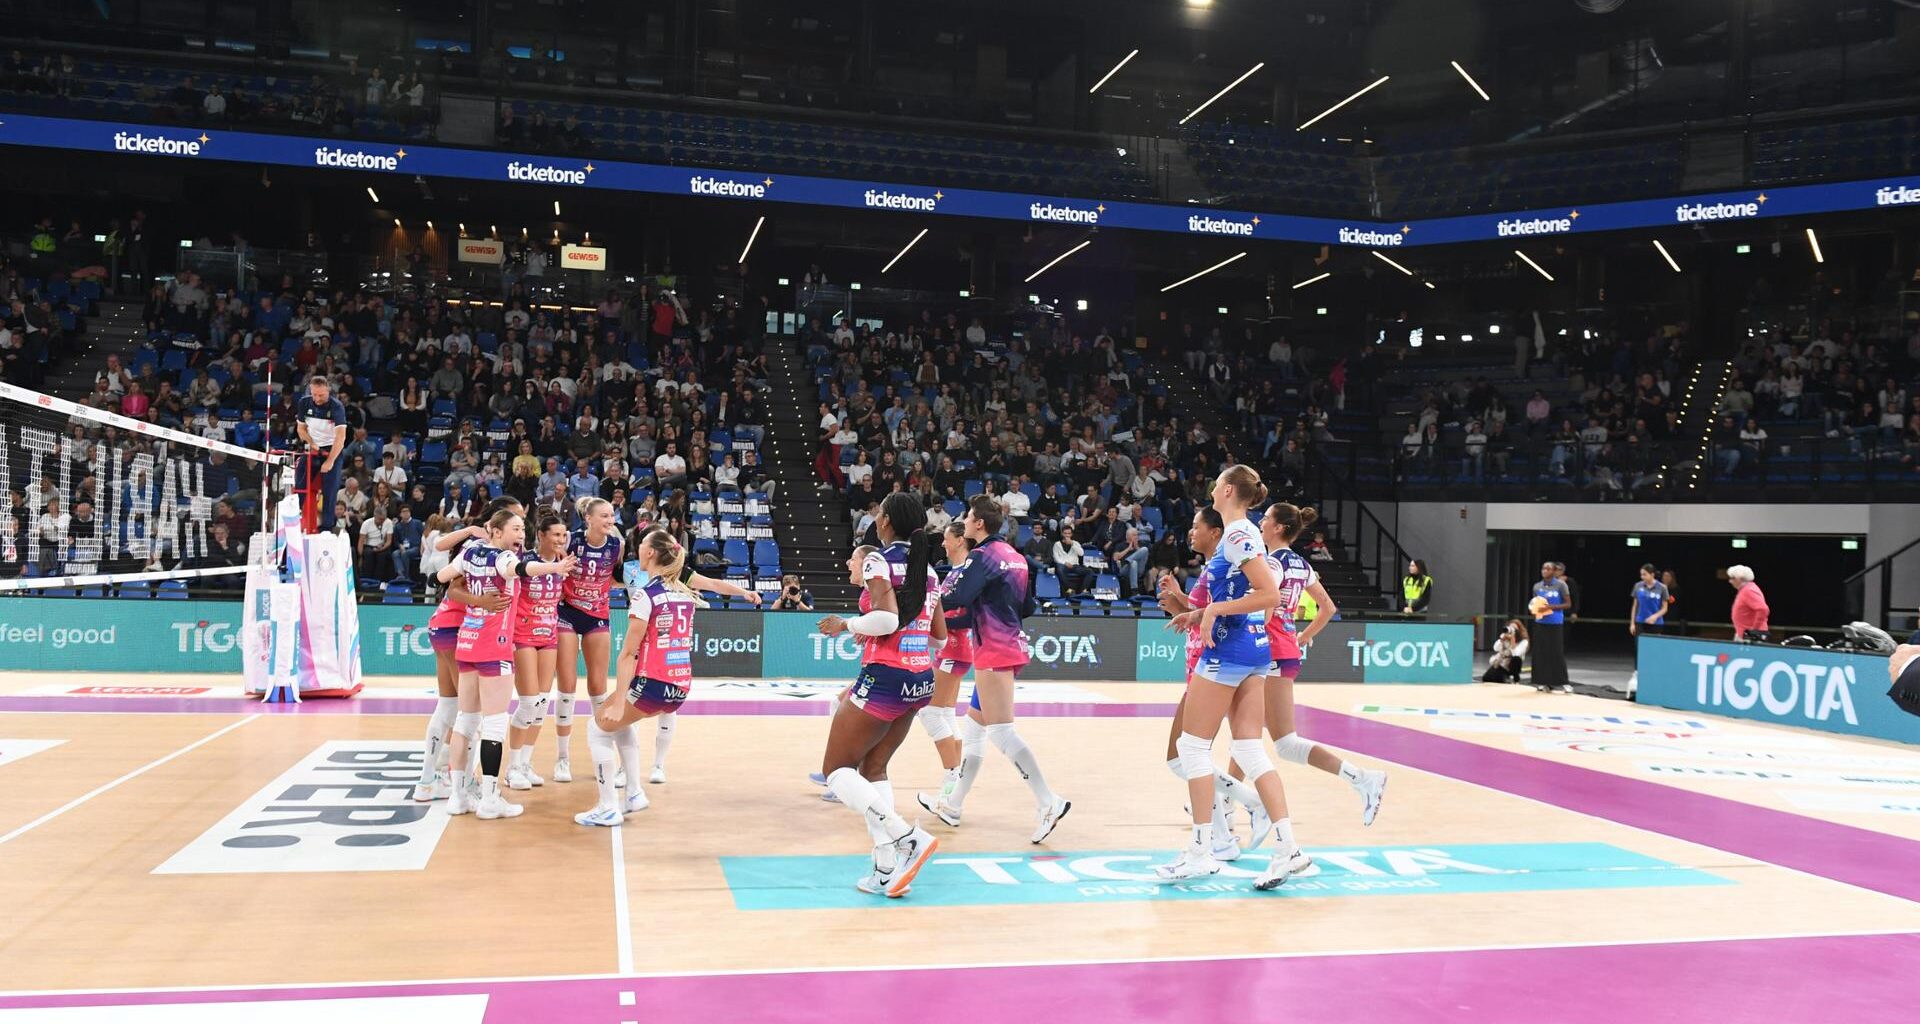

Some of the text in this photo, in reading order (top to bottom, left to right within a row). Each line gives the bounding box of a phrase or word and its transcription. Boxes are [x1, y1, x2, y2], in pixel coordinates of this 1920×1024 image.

[114, 132, 200, 155] ticketone
[315, 147, 397, 170] ticketone
[507, 162, 585, 185] ticketone
[690, 176, 764, 198] ticketone
[865, 189, 935, 211] ticketone
[1031, 203, 1098, 224] ticketone
[1676, 201, 1757, 222] ticketone
[1188, 215, 1253, 236] ticketone
[1498, 217, 1571, 236] ticketone
[1339, 227, 1403, 246] ticketone
[568, 252, 599, 262] GEWISS
[588, 560, 597, 575] 9
[546, 574, 554, 590] 3
[755, 581, 782, 590] MURATA
[677, 605, 687, 633] 5
[0, 625, 116, 648] feel good
[706, 635, 760, 656] good
[1139, 640, 1178, 661] play
